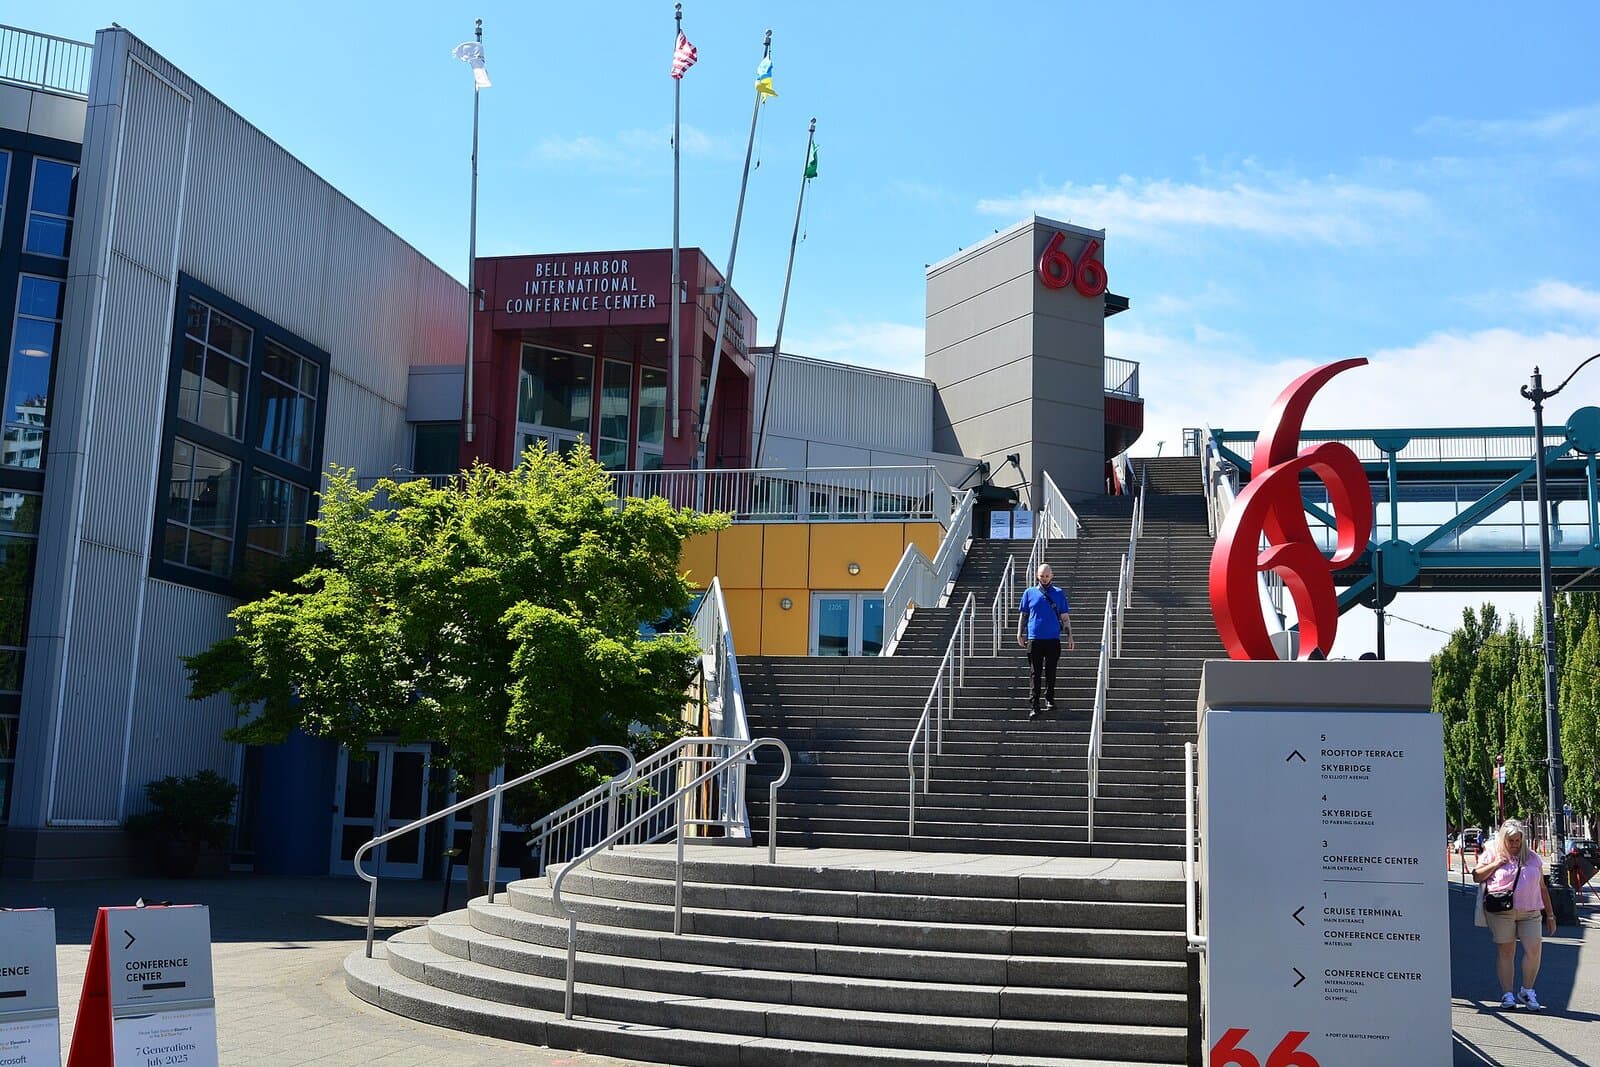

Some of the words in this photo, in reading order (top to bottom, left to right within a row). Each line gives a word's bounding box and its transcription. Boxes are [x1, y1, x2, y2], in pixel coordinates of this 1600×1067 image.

[536, 262, 568, 277] BELL
[574, 259, 629, 276] HARBOR
[1040, 230, 1108, 297] 66
[525, 277, 637, 295] INTERNATIONAL
[506, 296, 599, 313] CONFERENCE
[604, 294, 656, 310] CENTER
[1320, 734, 1326, 742] 5
[1321, 749, 1363, 757] ROOFTOP
[1365, 750, 1405, 758] TERRACE
[1321, 764, 1372, 772] SKYBRIDGE
[1321, 794, 1327, 802] 4
[1322, 809, 1373, 818] SKYBRIDGE
[1322, 840, 1328, 848] 3
[1322, 855, 1383, 864] CONFERENCE
[1384, 856, 1419, 865] CENTER
[1323, 891, 1327, 900] 1
[1323, 907, 1356, 916] CRUISE
[1358, 908, 1403, 917] TERMINAL
[1323, 930, 1384, 940] CONFERENCE
[1386, 932, 1421, 942] CENTER
[125, 958, 189, 971] CONFERENCE
[126, 971, 162, 982] CENTER
[1324, 969, 1385, 979] CONFERENCE
[1387, 972, 1422, 981] CENTER
[136, 1047, 142, 1057] 7
[142, 1042, 196, 1056] Generations
[1209, 1028, 1321, 1067] 66
[147, 1057, 163, 1067] July
[165, 1054, 188, 1065] 2025
